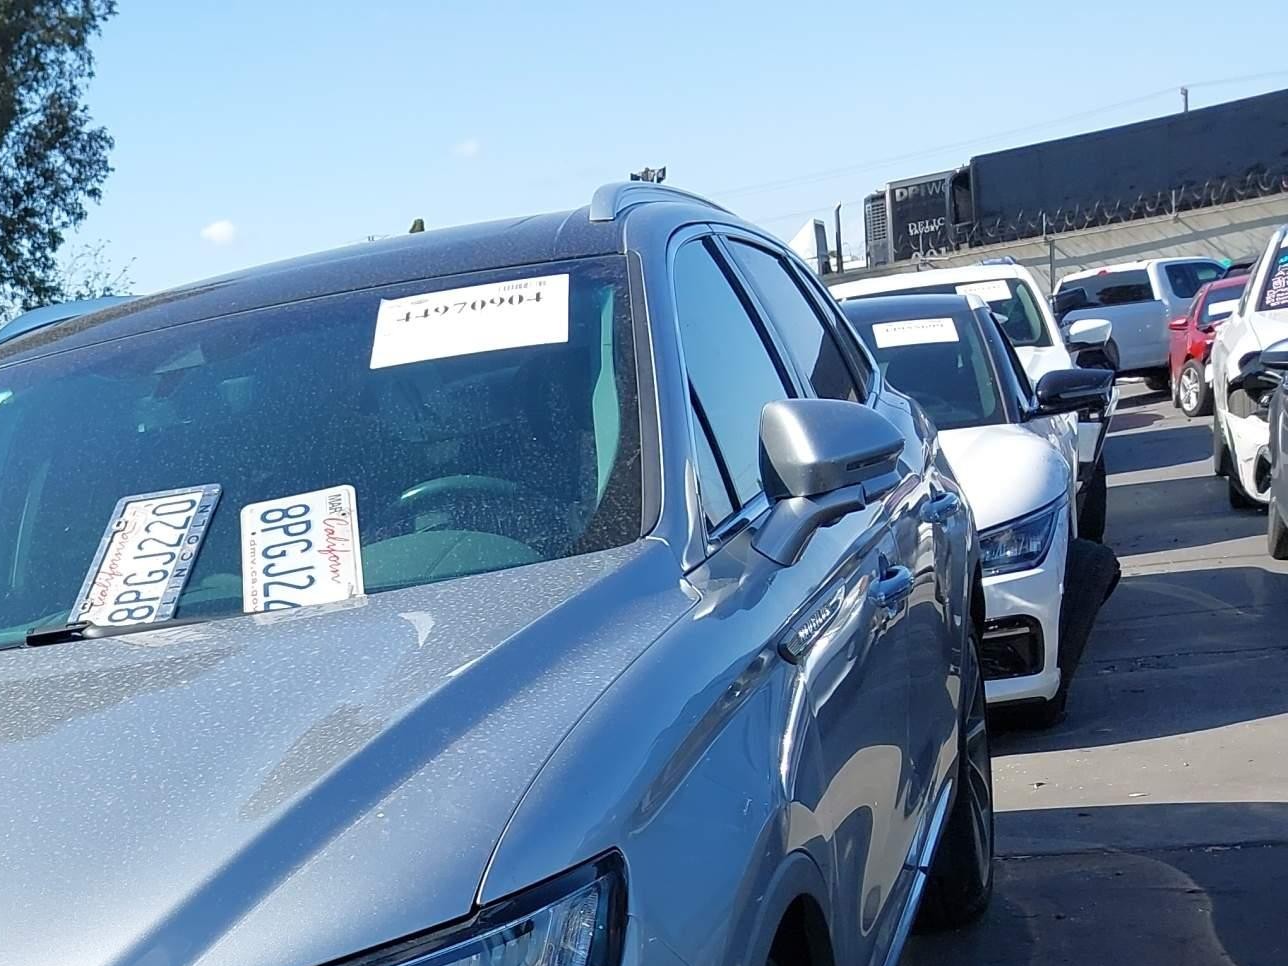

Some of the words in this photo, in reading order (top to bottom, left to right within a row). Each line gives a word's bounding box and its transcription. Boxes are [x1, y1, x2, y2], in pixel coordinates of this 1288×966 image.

[396, 291, 544, 323] 44970904
[108, 499, 197, 623] 8PGJ220
[162, 504, 211, 606] LINCOLN
